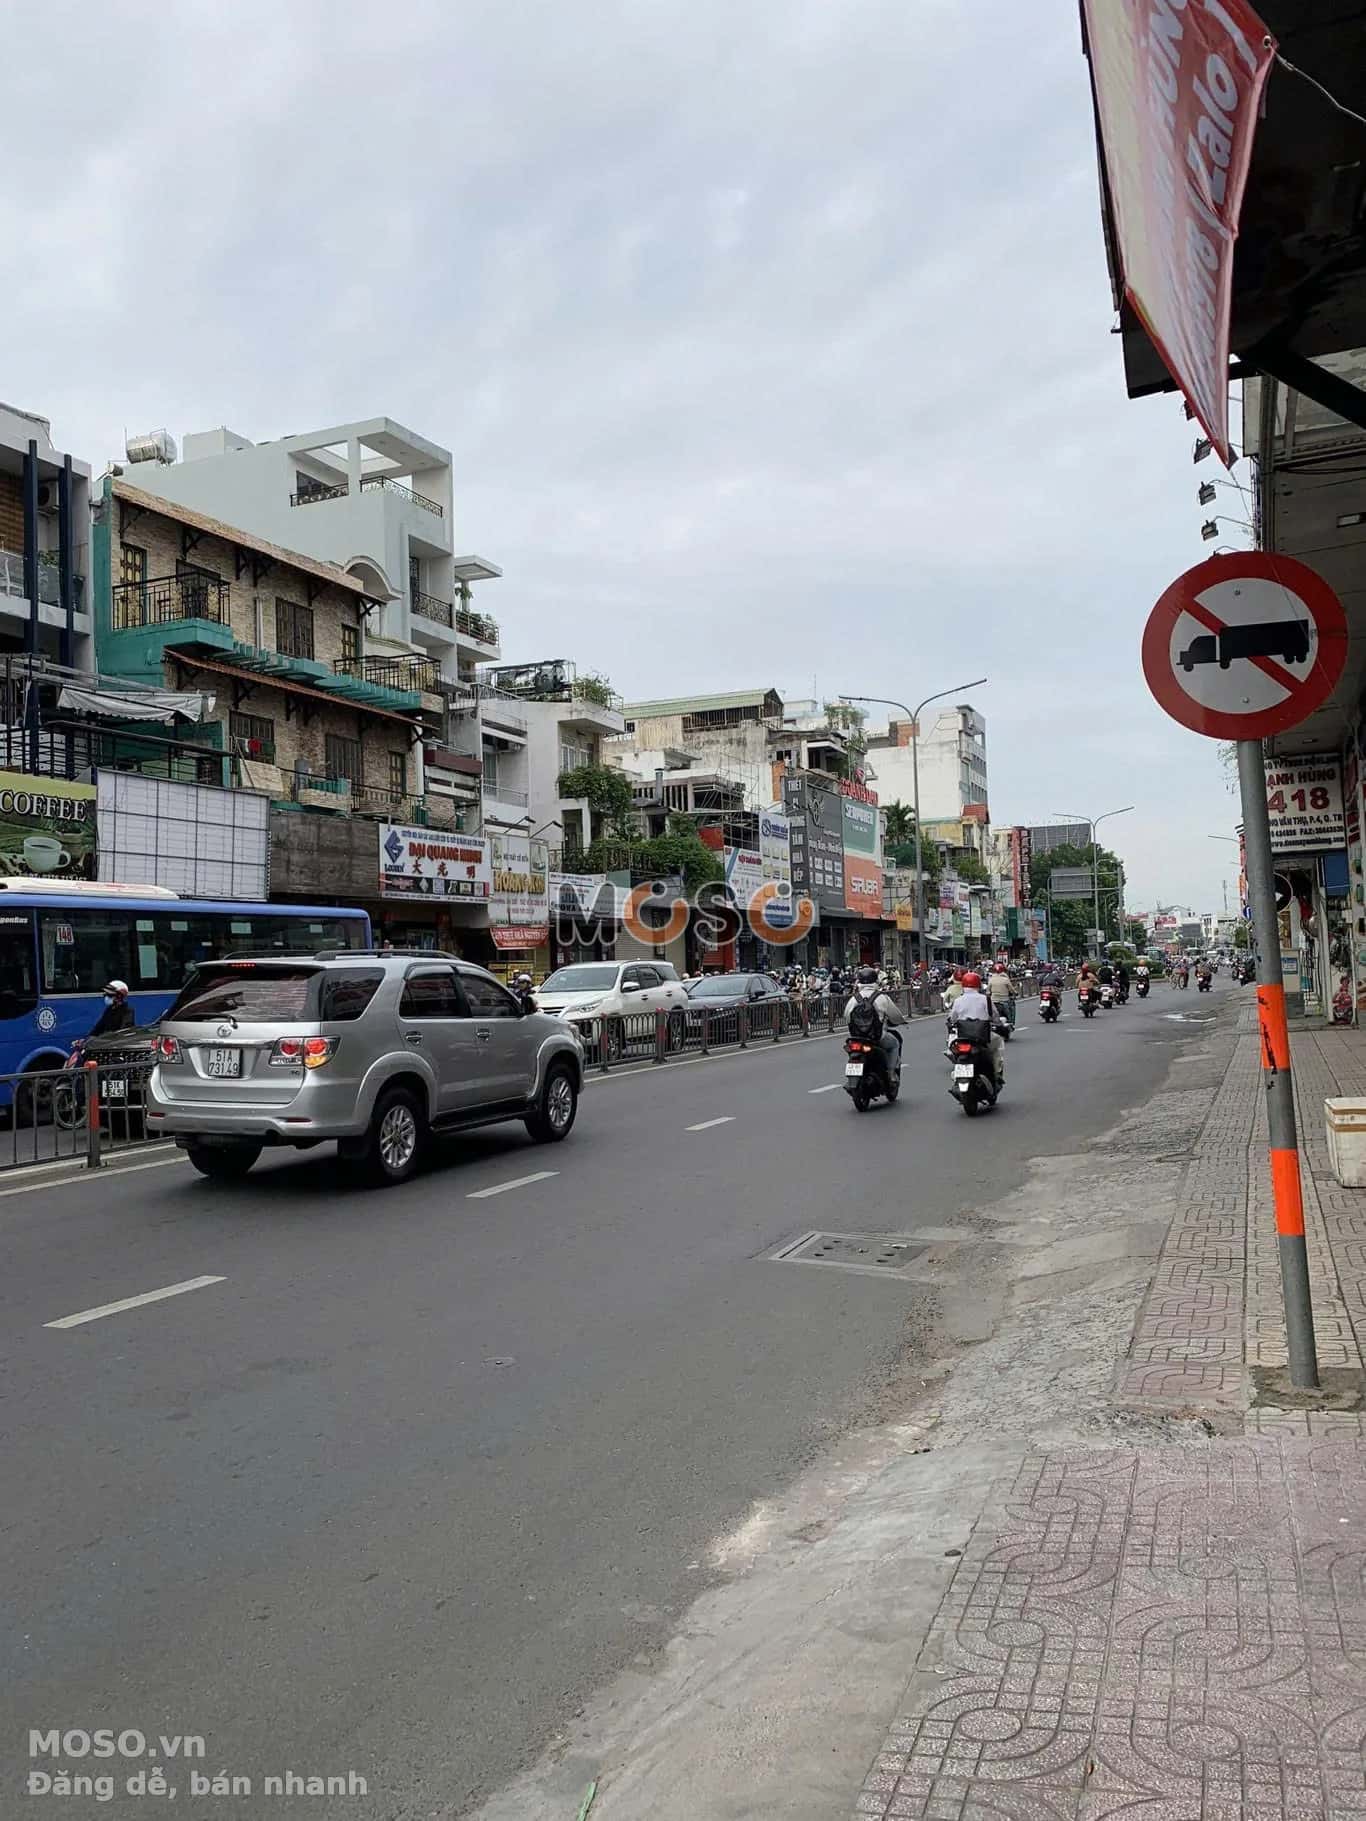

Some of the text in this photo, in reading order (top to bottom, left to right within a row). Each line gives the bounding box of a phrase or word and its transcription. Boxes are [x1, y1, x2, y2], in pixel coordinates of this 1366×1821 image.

[0, 788, 87, 821] COFFEE
[1267, 787, 1330, 813] 418
[427, 844, 460, 864] QUANG
[216, 1049, 233, 1063] 51A
